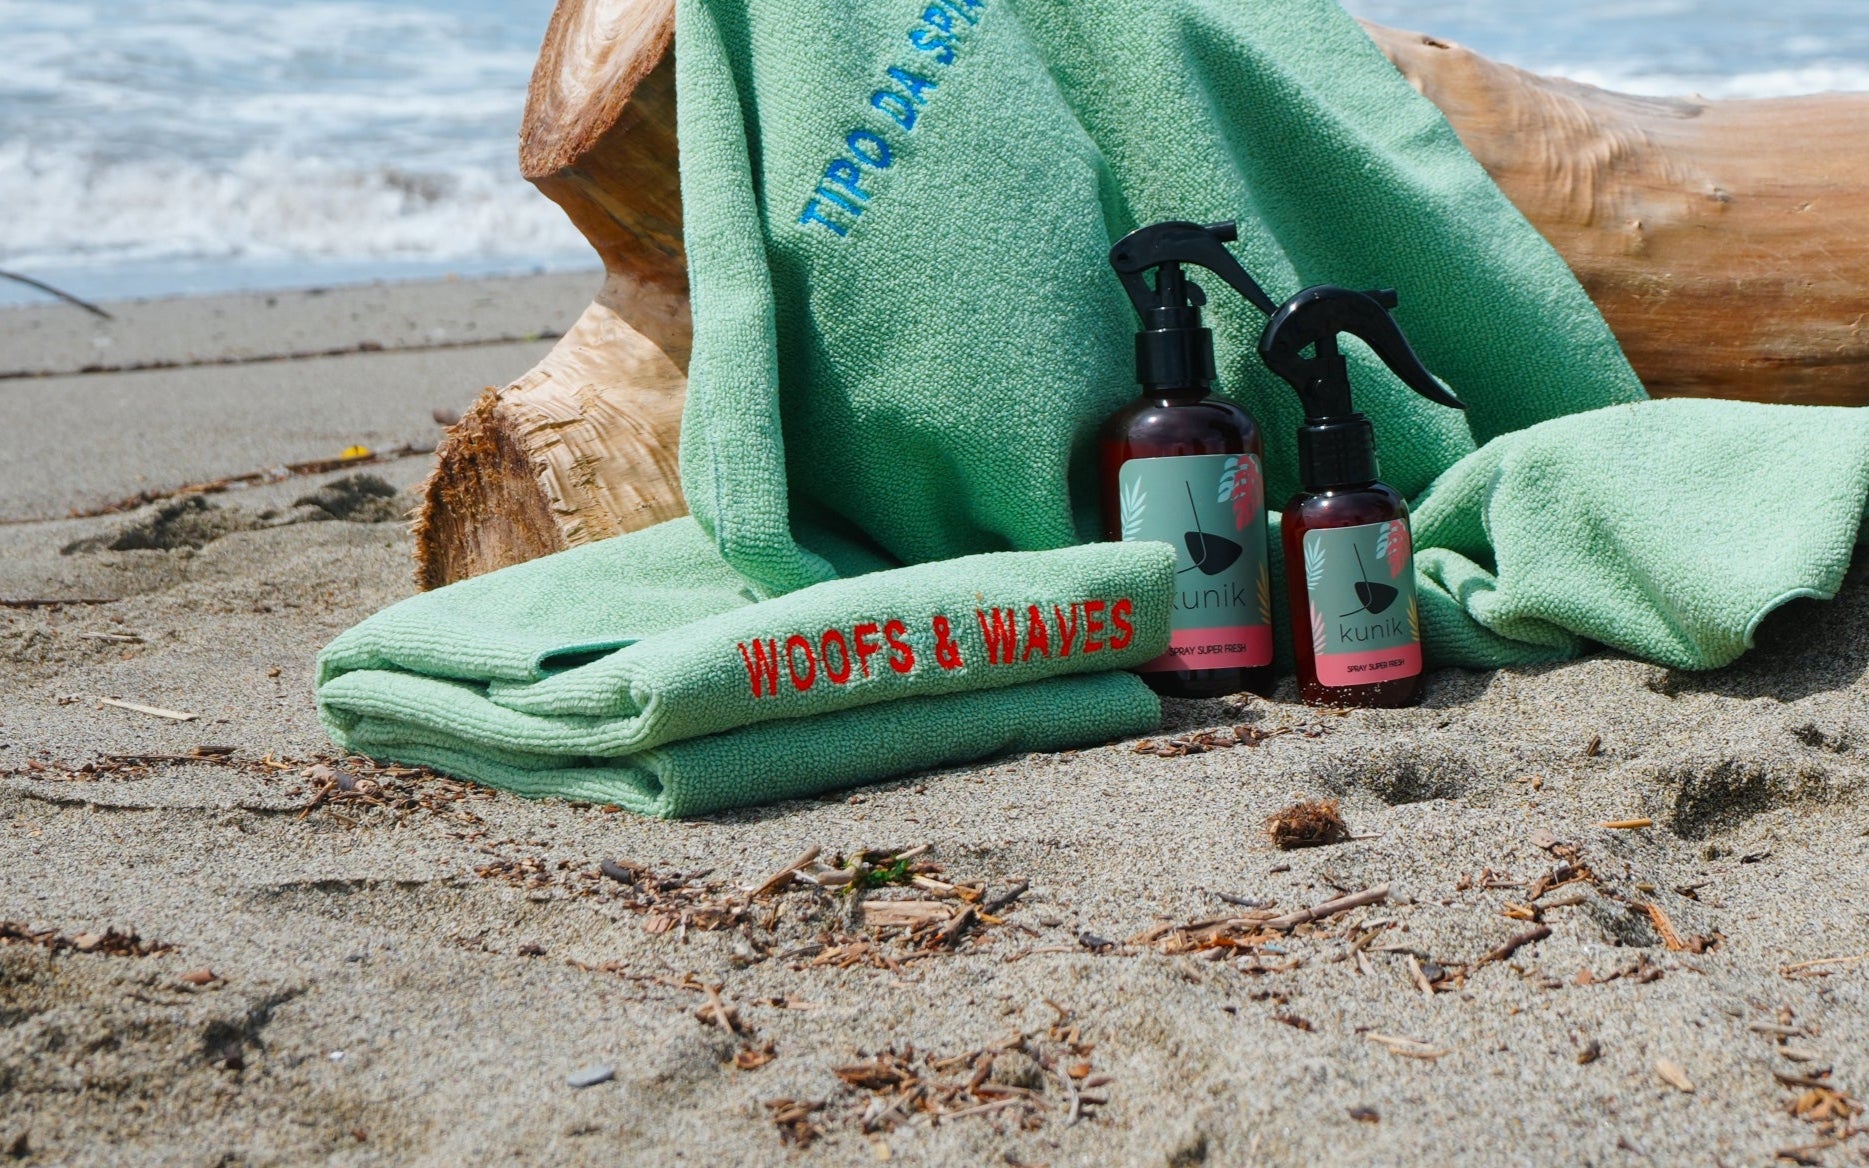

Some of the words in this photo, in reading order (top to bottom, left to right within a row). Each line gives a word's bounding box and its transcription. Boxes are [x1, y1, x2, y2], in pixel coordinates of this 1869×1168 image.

[799, 130, 893, 237] TIPO
[871, 66, 938, 131] DA
[1339, 617, 1403, 643] kunik
[737, 618, 916, 699] WOOFS
[932, 615, 963, 671] &
[975, 598, 1134, 665] WAVES
[1168, 646, 1196, 656] SPRAY
[1197, 644, 1223, 655] SUPER
[1224, 643, 1247, 653] FRESH
[1347, 664, 1367, 673] SPRAY
[1368, 661, 1388, 671] SUPER
[1389, 658, 1405, 668] FRESH
